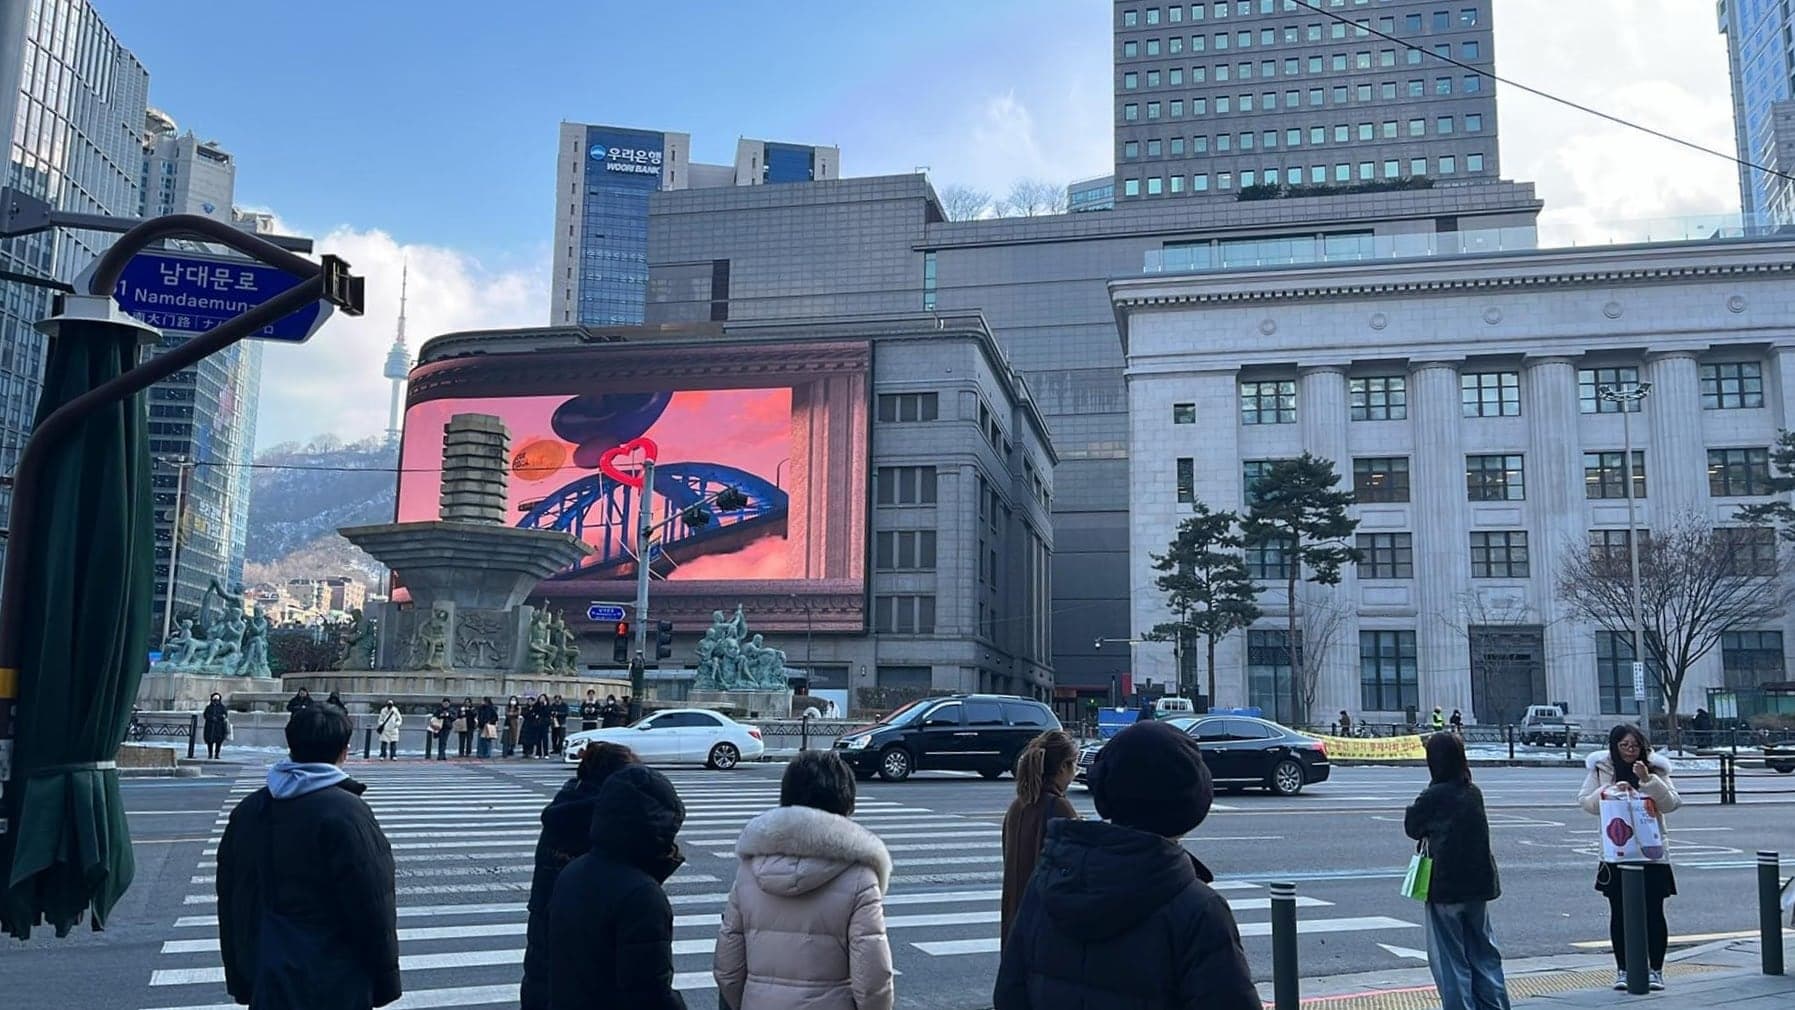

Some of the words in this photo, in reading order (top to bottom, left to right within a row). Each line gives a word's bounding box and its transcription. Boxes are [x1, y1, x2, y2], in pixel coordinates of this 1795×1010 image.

[608, 147, 662, 165] 우리은행
[635, 165, 661, 174] BANK
[160, 262, 258, 292] 남대문로
